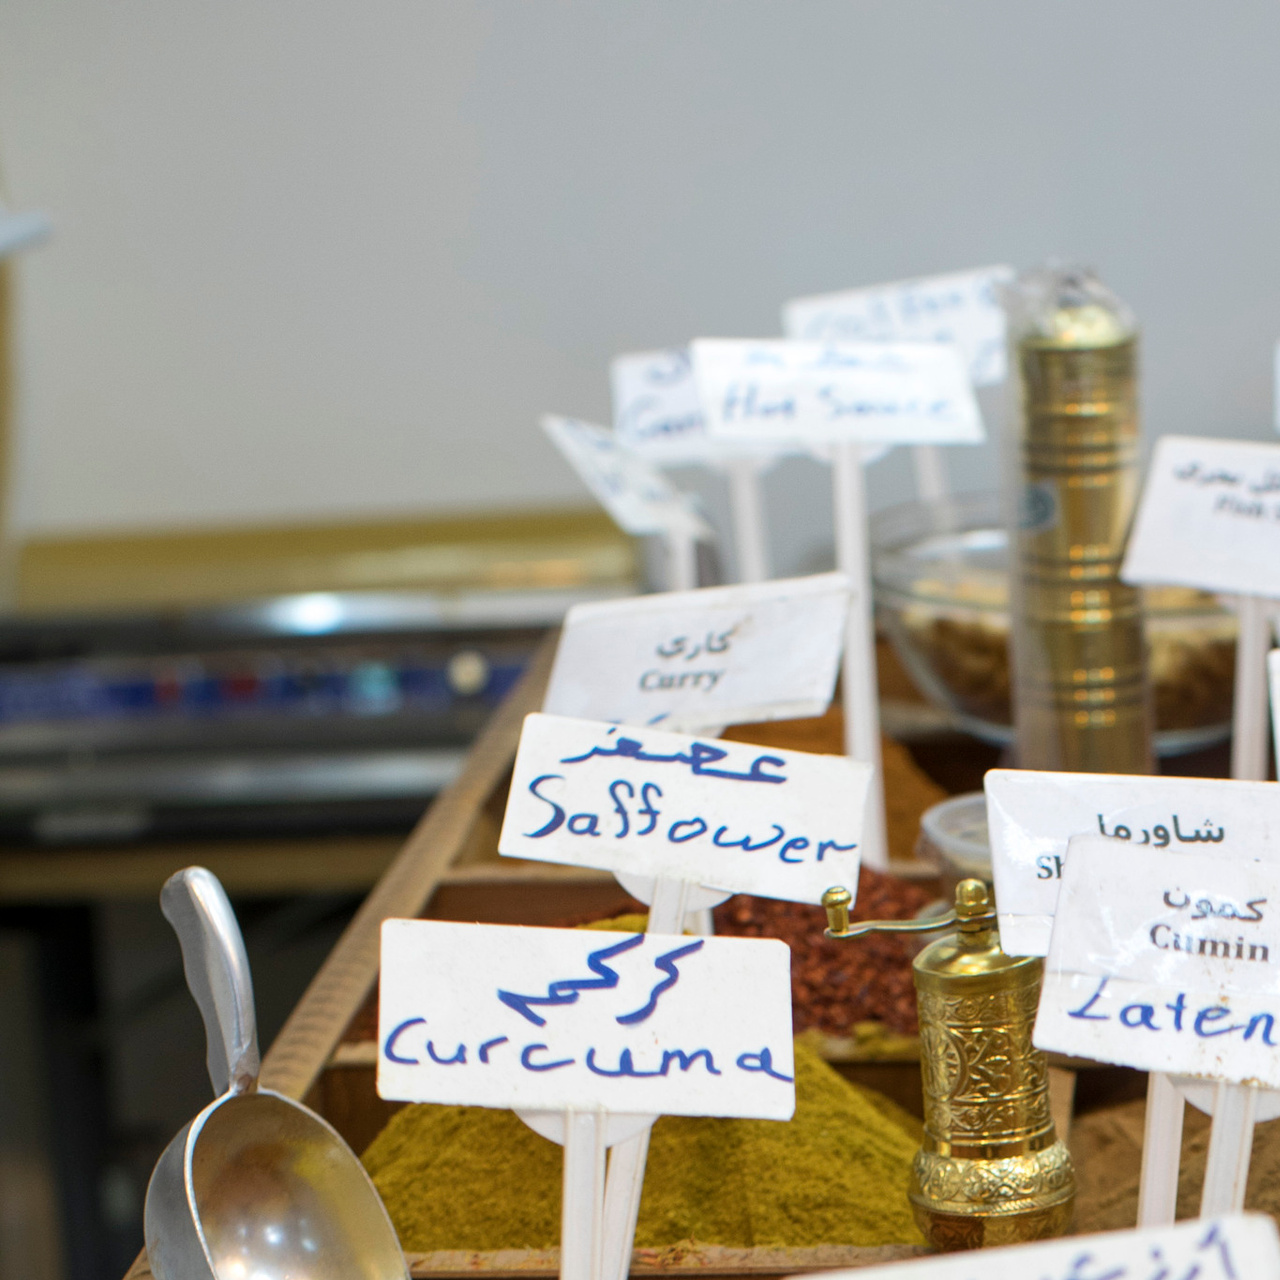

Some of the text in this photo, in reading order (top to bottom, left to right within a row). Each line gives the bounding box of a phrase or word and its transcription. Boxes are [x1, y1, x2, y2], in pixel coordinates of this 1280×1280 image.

[638, 667, 726, 693] Curry
[1097, 813, 1226, 848] شاورما
[1163, 885, 1268, 922] كمون
[384, 1017, 794, 1083] Curcuma
